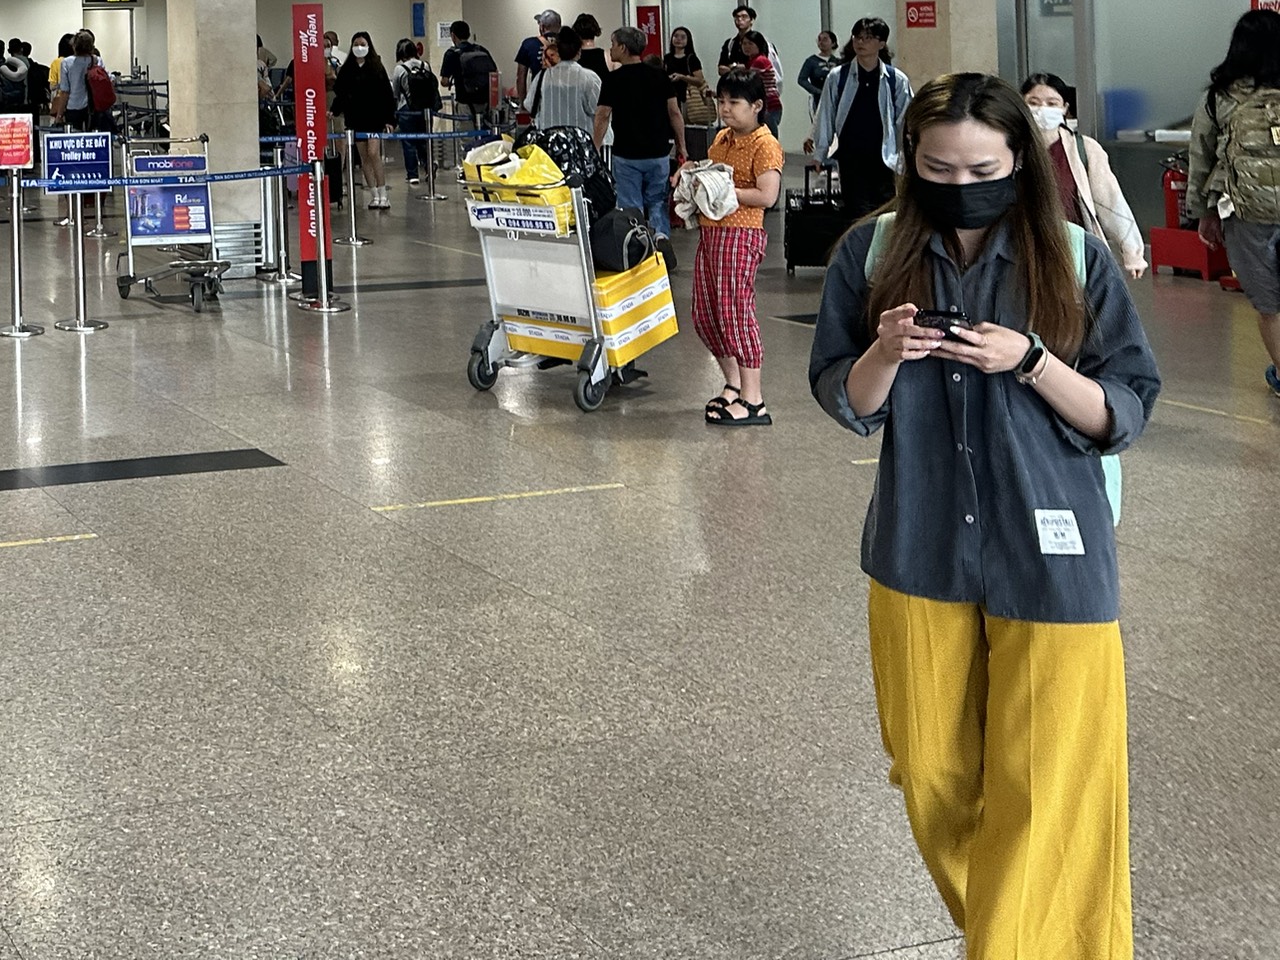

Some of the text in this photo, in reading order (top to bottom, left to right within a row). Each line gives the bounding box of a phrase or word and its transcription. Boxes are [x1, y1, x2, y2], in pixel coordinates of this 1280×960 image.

[305, 89, 316, 127] Online
[50, 140, 62, 149] KHU
[63, 139, 75, 150] VỰC
[85, 139, 93, 148] XE
[61, 151, 95, 161] Trolley here
[148, 160, 193, 168] mobifone
